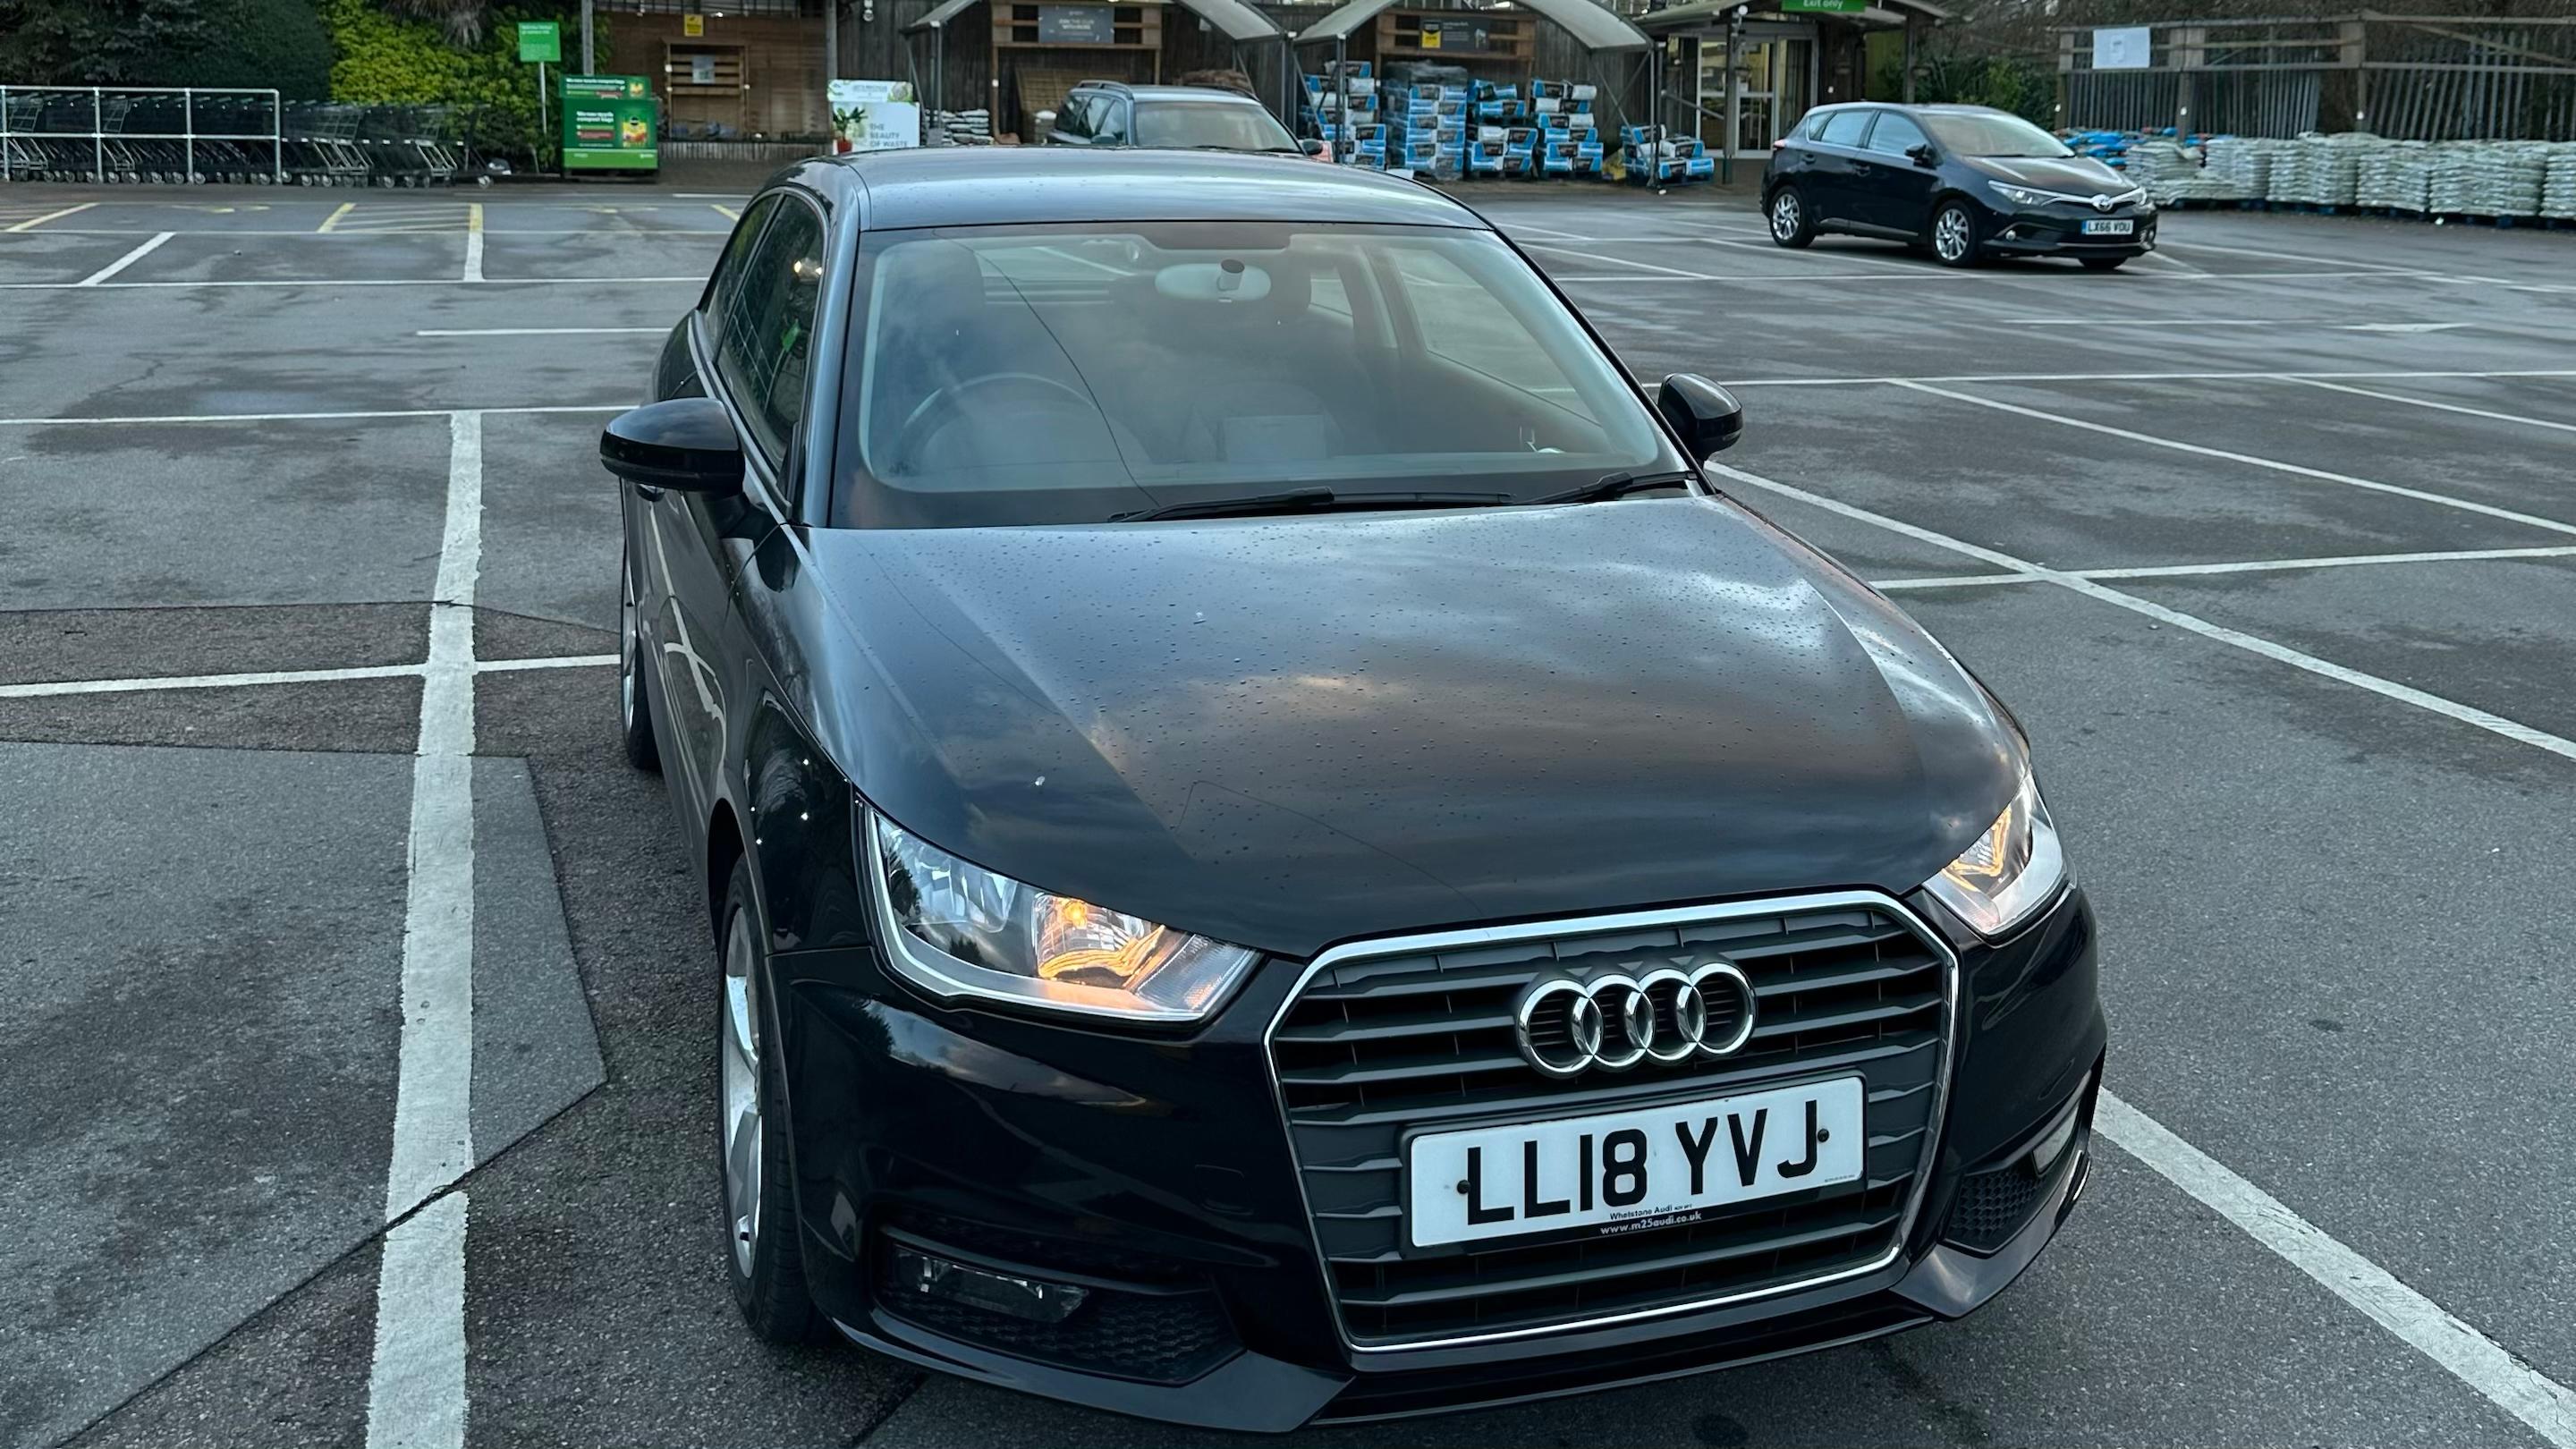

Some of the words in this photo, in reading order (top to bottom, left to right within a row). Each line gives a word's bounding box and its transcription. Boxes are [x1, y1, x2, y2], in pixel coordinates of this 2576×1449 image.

[1468, 1129, 1647, 1225] LL18
[1675, 1099, 1817, 1195] YVJ
[1655, 1205, 1672, 1213] Audi
[1600, 1211, 1702, 1234] www.m25audi.co.uk
